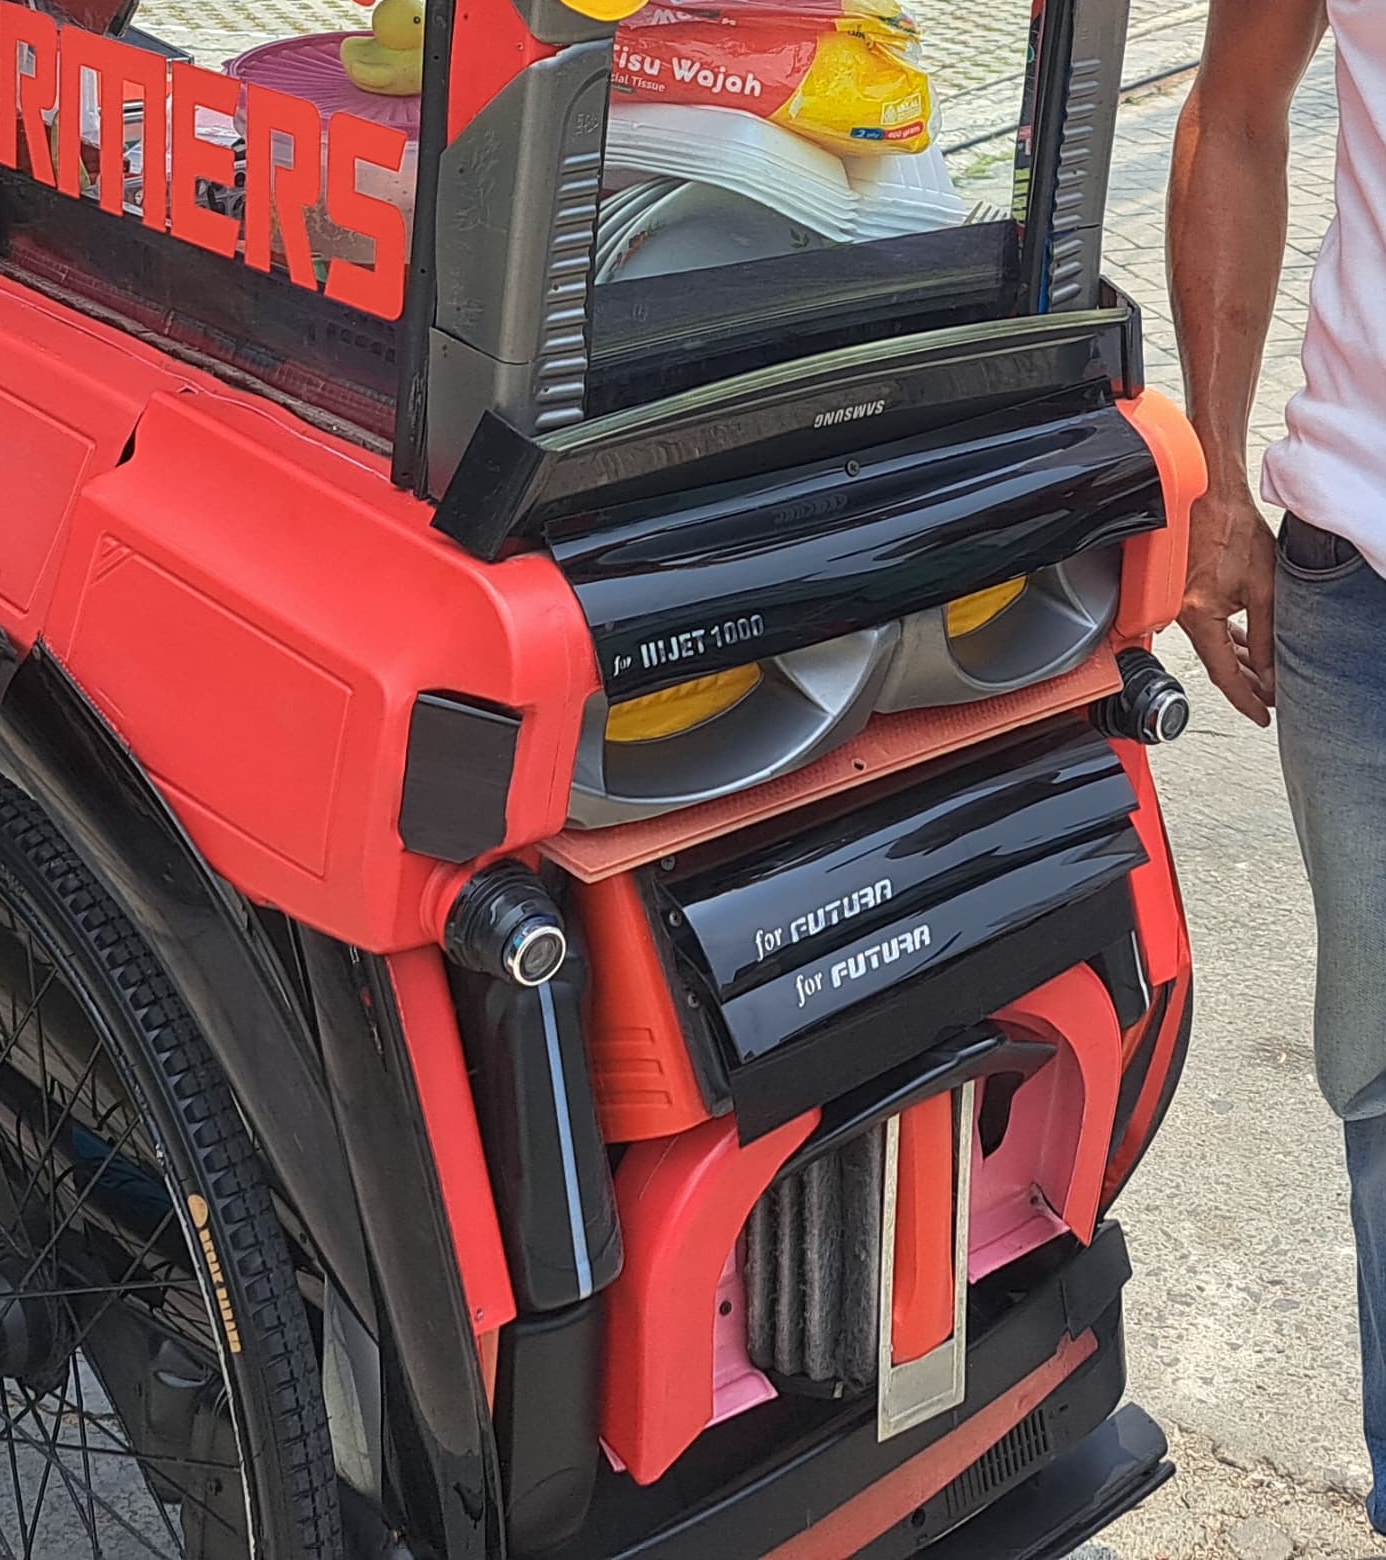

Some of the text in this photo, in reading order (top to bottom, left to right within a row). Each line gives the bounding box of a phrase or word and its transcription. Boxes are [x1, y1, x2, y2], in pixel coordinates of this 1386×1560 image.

[671, 56, 762, 97] Wajah
[813, 397, 886, 430] SAMSUNG
[710, 613, 765, 648] 1000
[755, 877, 894, 961] for FUTURA
[794, 923, 932, 1007] for FUTURA
